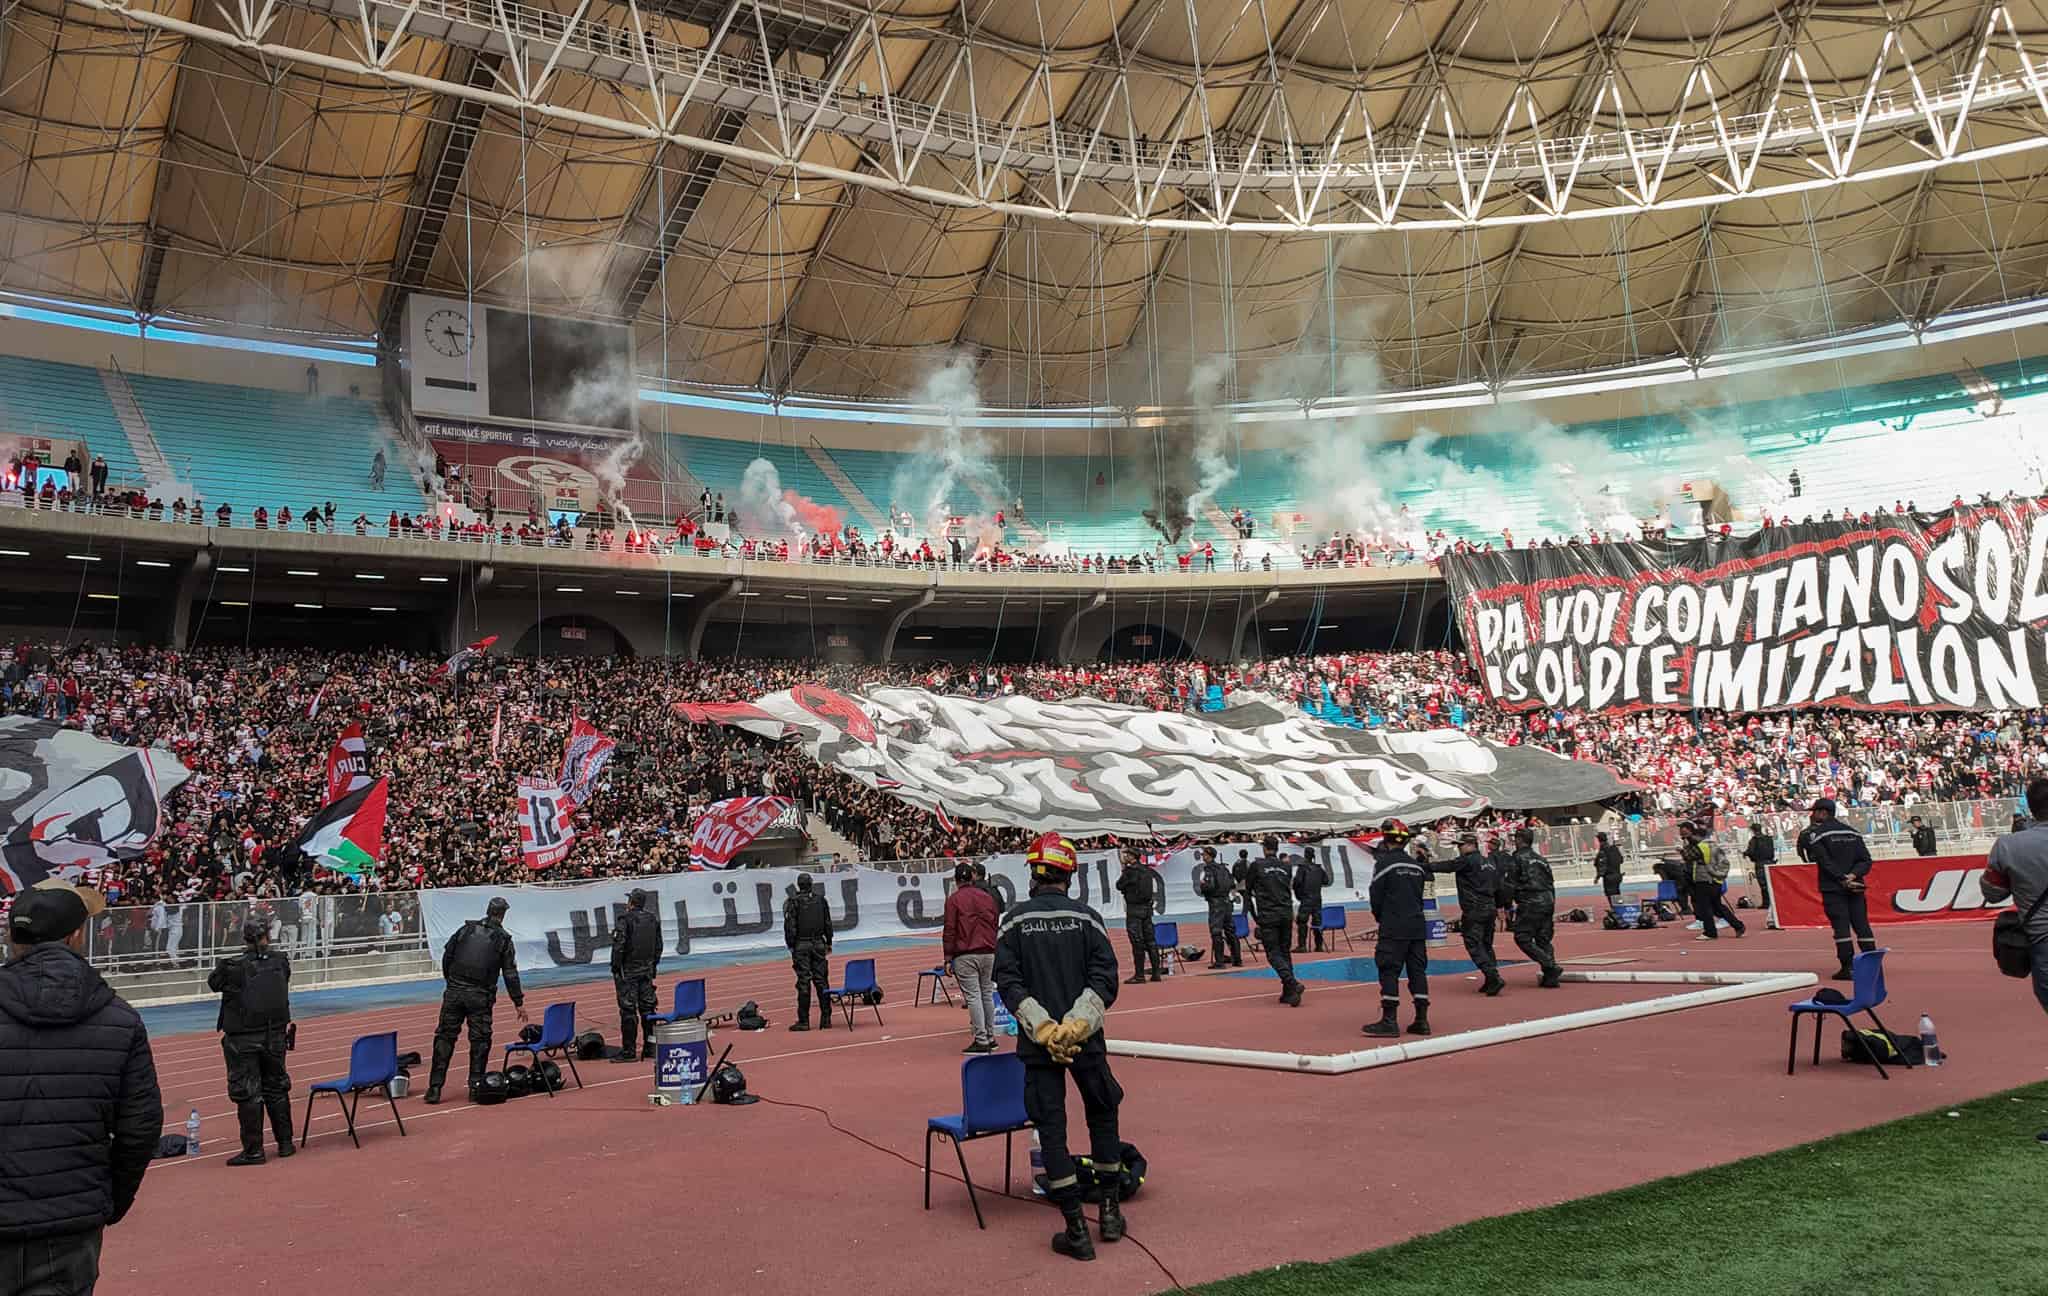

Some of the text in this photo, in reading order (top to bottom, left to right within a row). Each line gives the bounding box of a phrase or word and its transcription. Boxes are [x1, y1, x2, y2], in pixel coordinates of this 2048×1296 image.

[480, 429, 513, 442] SPORTIVE
[1476, 601, 1527, 656] DA
[1544, 588, 1622, 645] VOI
[1631, 542, 1920, 646] CONTANO
[1505, 644, 1643, 710] SOLDI
[1650, 643, 1680, 704] E
[1692, 623, 2048, 712] IMITAZION
[1090, 751, 1473, 816] GRATA
[529, 794, 562, 847] 12
